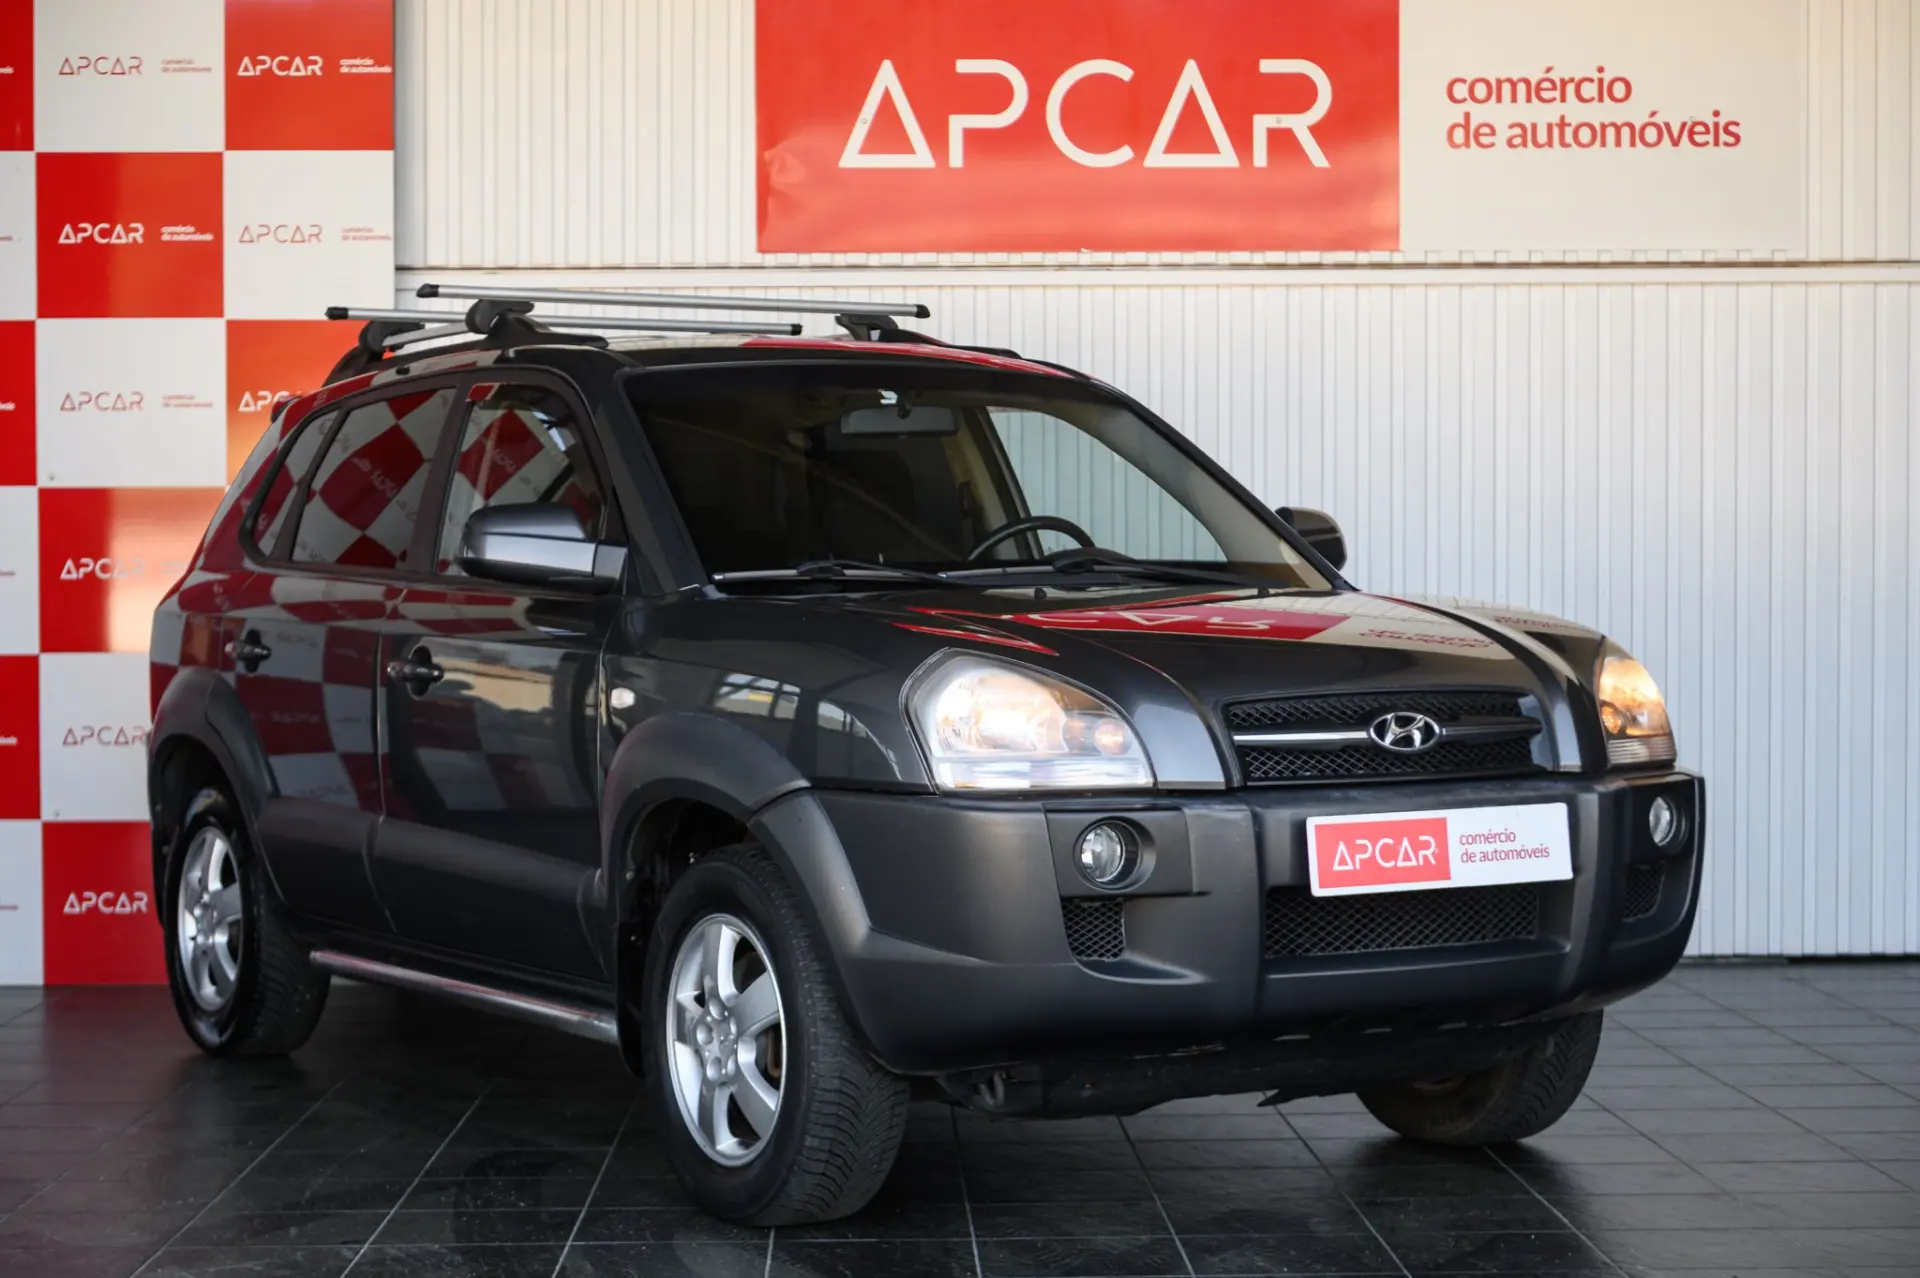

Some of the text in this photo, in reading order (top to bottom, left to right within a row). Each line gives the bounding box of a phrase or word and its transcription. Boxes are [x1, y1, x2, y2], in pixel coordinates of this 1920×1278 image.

[58, 56, 142, 75] APCAR
[237, 56, 323, 76] APCAR
[1446, 66, 1633, 104] comércio
[838, 58, 1331, 168] APCAR
[1446, 110, 1742, 149] de automóveis
[58, 223, 144, 244] APCAR
[238, 225, 323, 243] APCAR
[60, 392, 144, 411] APCAR
[62, 726, 146, 746] APCAR
[1459, 828, 1516, 846] comércio
[1332, 835, 1437, 871] APCAR
[1460, 843, 1550, 863] de automóveis
[63, 892, 149, 914] APCAR
